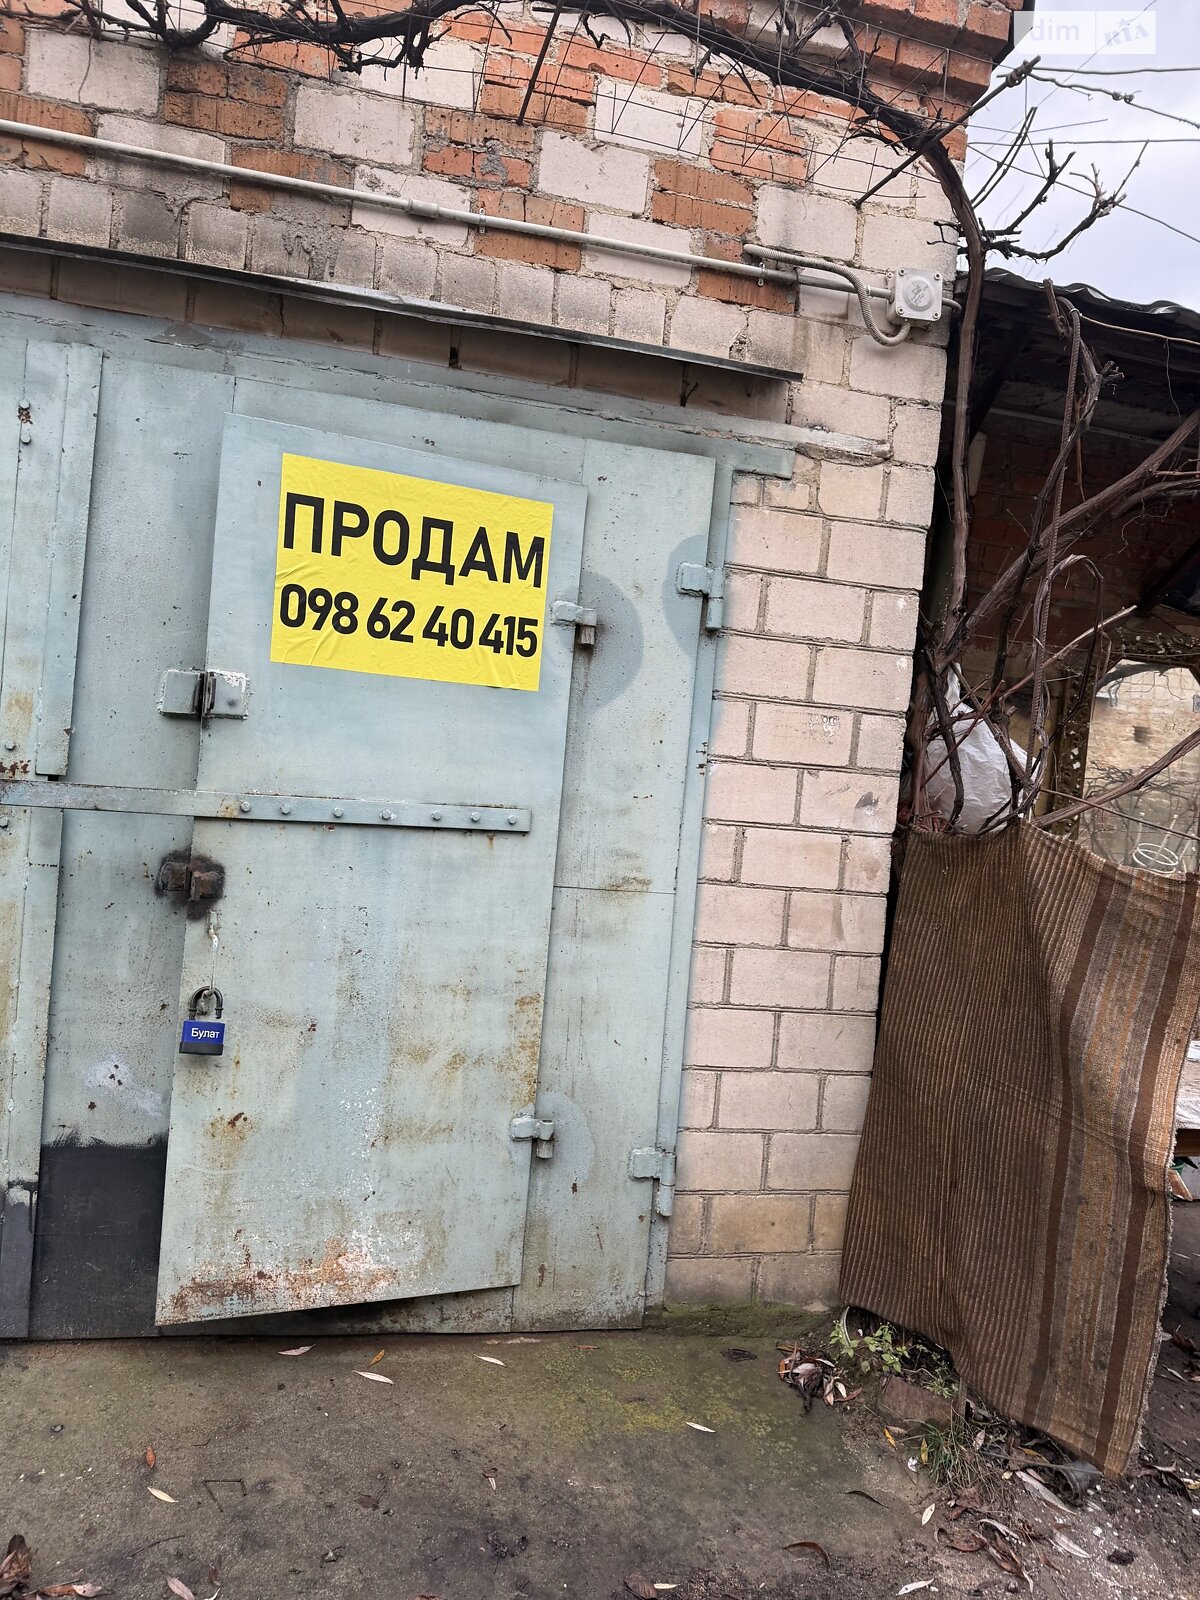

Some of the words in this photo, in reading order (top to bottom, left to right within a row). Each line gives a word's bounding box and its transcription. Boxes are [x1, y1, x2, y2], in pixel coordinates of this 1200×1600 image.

[283, 491, 545, 589] ПРОДАМ
[279, 583, 359, 635] 098
[366, 596, 416, 644] 62
[422, 605, 475, 650] 40
[478, 613, 539, 658] 415
[191, 1027, 220, 1040] Булат
